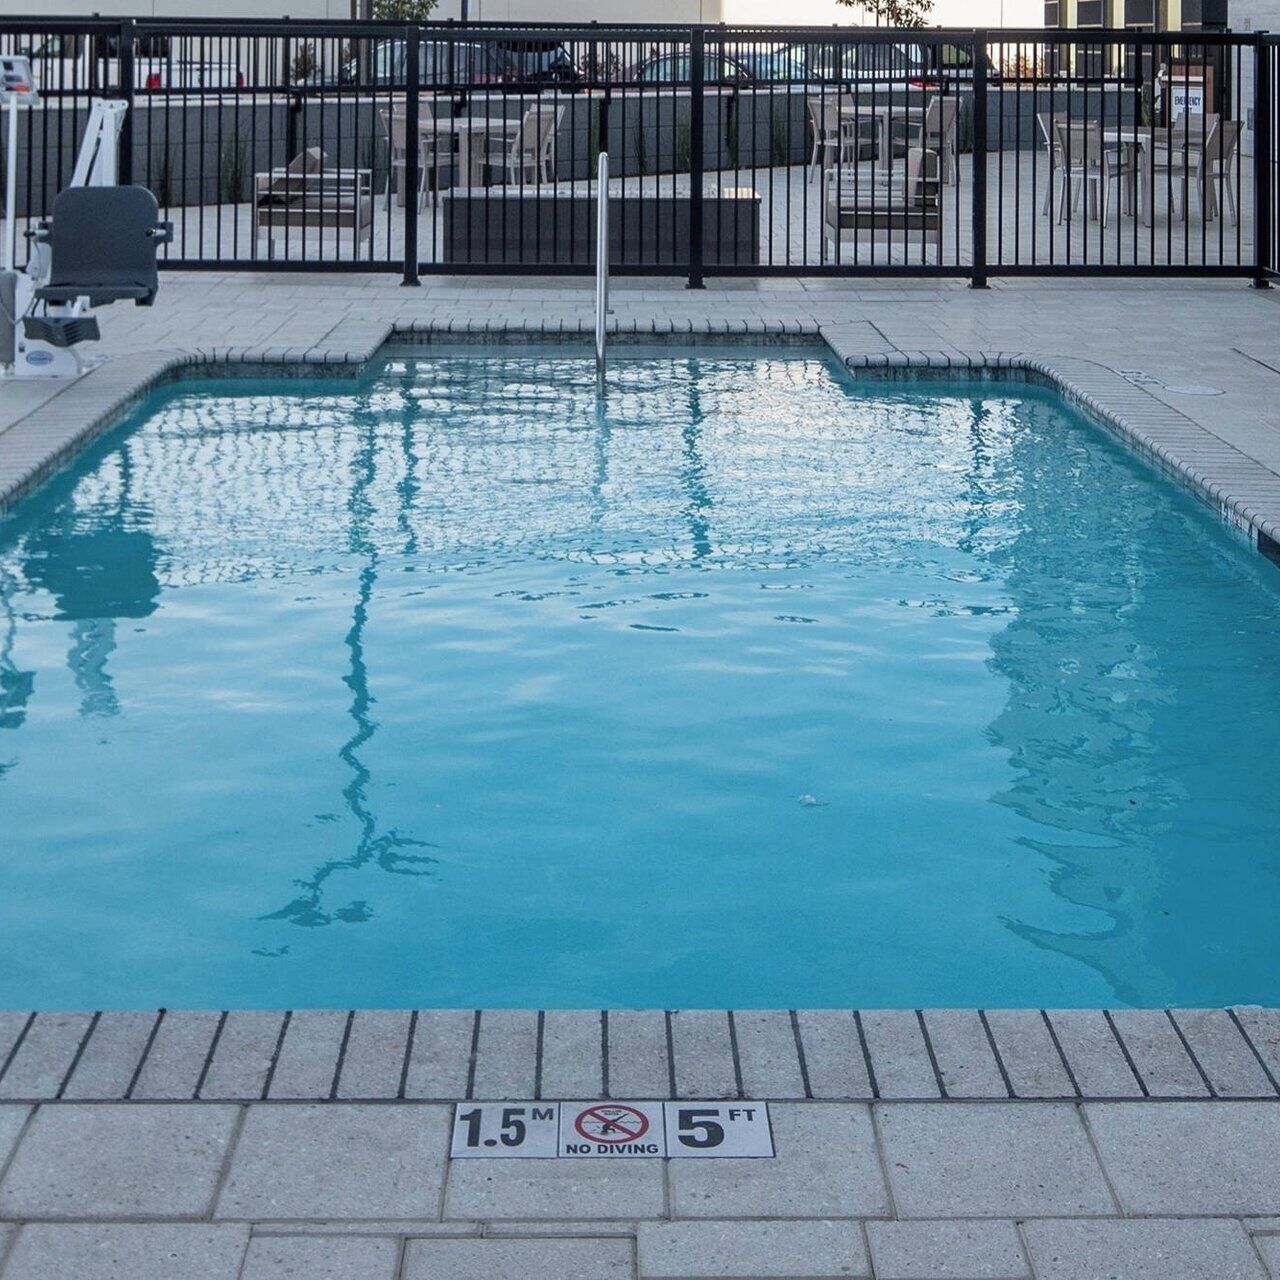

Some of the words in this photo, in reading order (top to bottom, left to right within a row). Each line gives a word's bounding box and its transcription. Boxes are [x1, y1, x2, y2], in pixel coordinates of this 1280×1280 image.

[459, 1108, 527, 1148] 1.5
[532, 1108, 554, 1121] M
[677, 1109, 725, 1148] 5
[729, 1109, 757, 1122] FT
[566, 1144, 592, 1155] NO
[597, 1144, 659, 1155] DIVING
